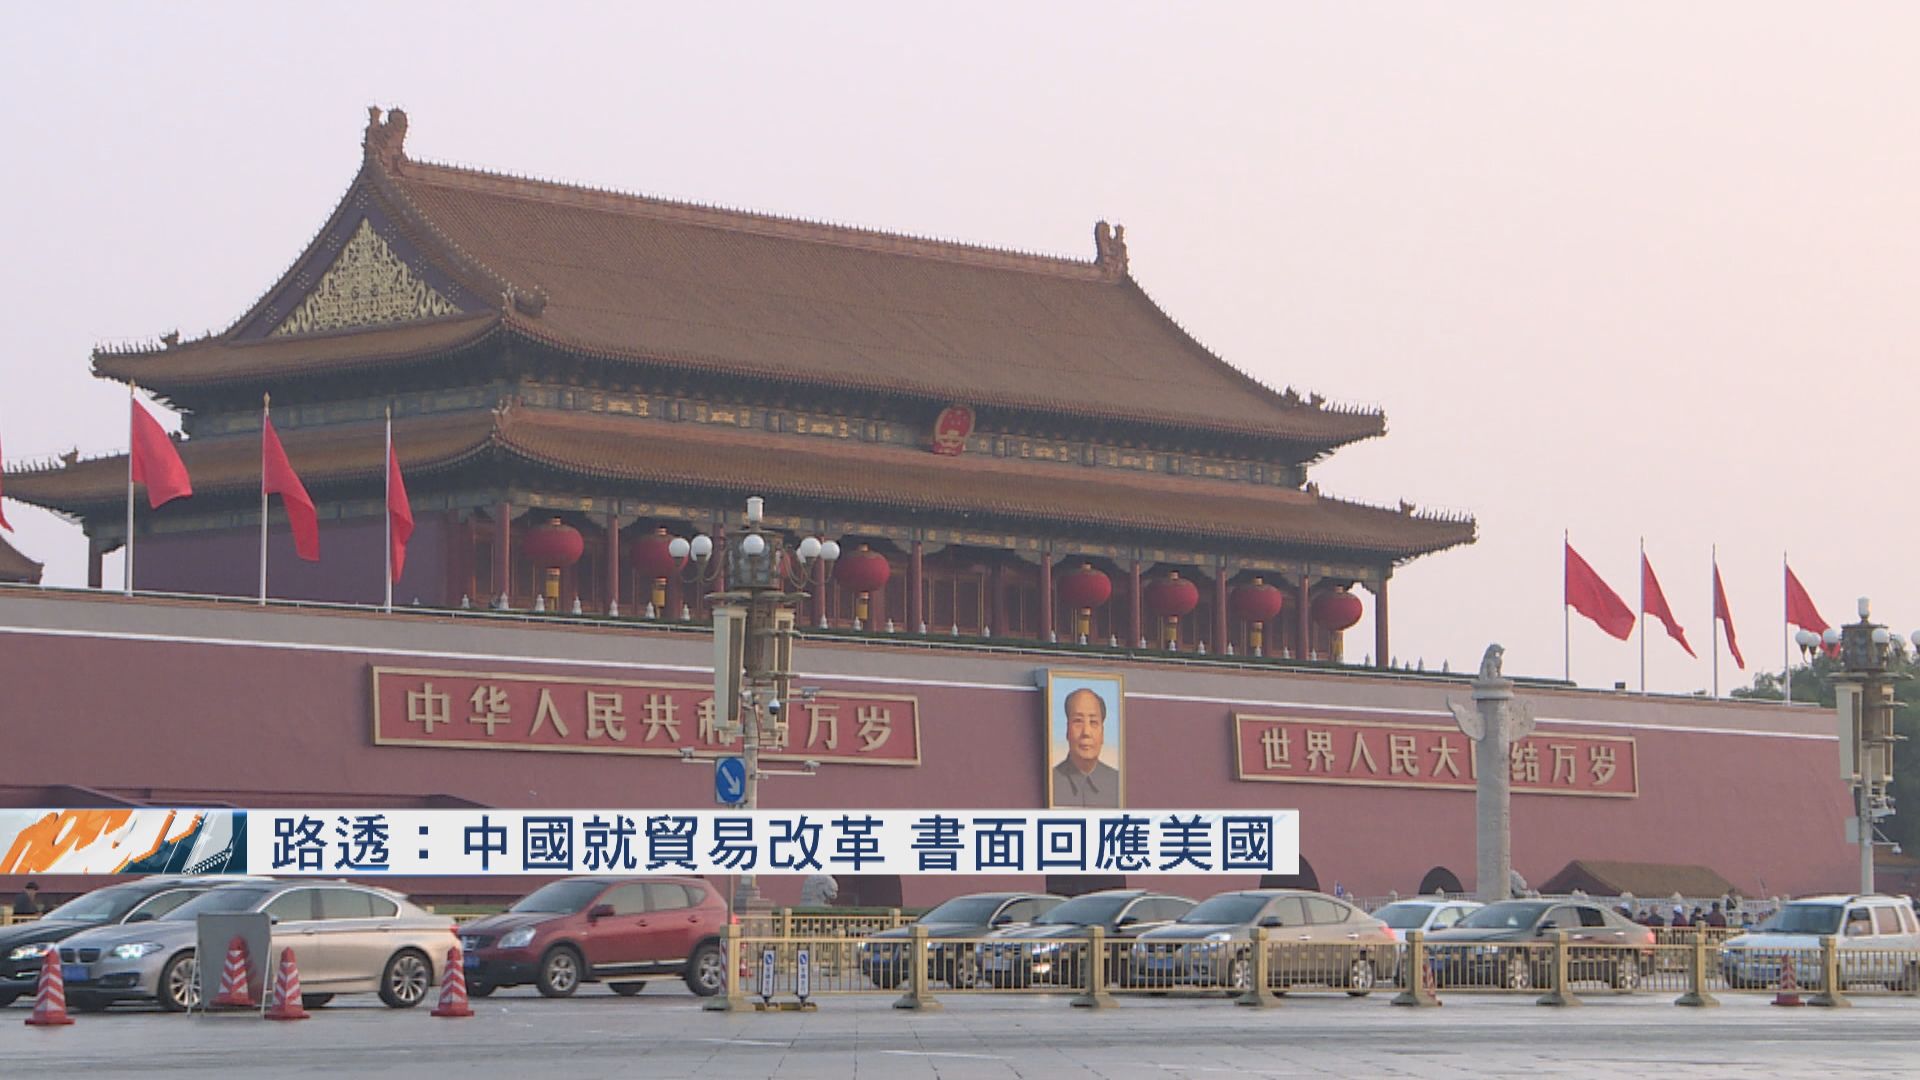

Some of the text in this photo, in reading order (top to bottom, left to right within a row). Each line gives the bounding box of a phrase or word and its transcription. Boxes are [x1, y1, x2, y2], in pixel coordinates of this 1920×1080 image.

[1261, 727, 1616, 784] 世界人民大结万岁
